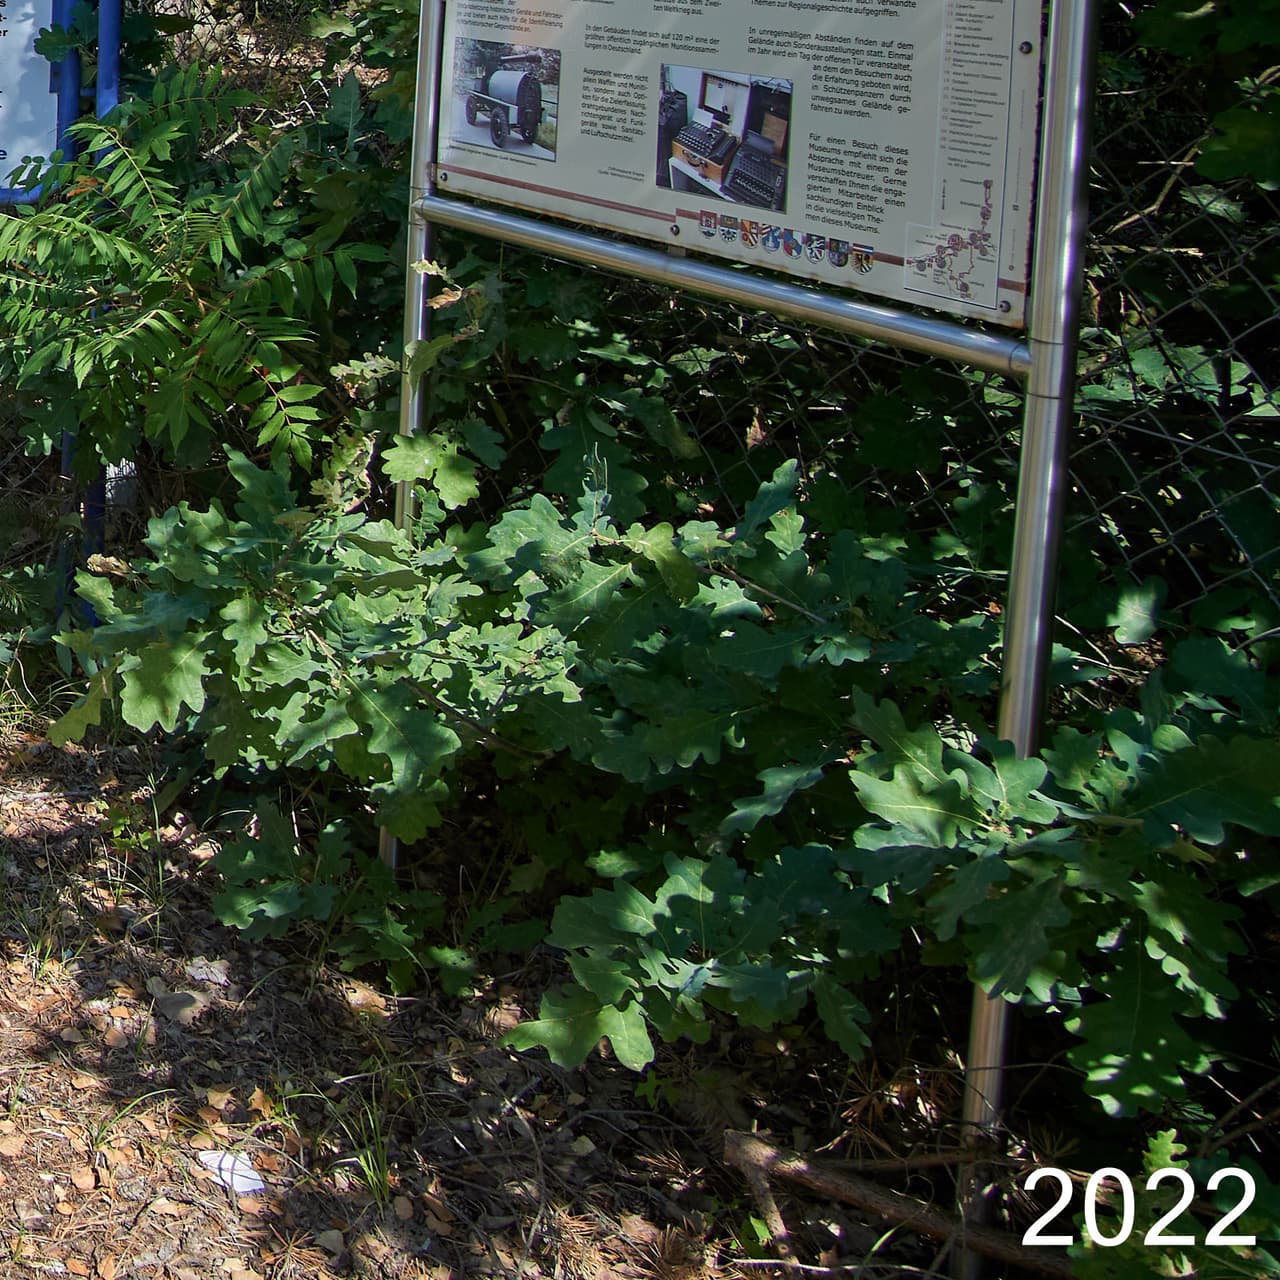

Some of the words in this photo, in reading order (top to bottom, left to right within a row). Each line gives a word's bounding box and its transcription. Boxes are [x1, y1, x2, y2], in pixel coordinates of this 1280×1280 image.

[788, 0, 852, 13] Regionalgeschichte
[854, 6, 900, 16] aufgegriffen.
[877, 0, 916, 8] verwandte
[748, 36, 774, 46] Gelände
[793, 41, 864, 56] Sonderausstellungen
[888, 50, 913, 60] Einmal
[749, 26, 755, 34] In
[759, 29, 810, 40] unregelmäßigen
[814, 33, 850, 43] Abständen
[855, 37, 876, 46] finden
[881, 40, 893, 48] auf
[897, 41, 913, 49] dem
[798, 51, 810, 61] Tag
[811, 53, 823, 61] der
[824, 54, 850, 64] offenen
[852, 57, 864, 65] Tür
[865, 60, 911, 72] veranstaltet,
